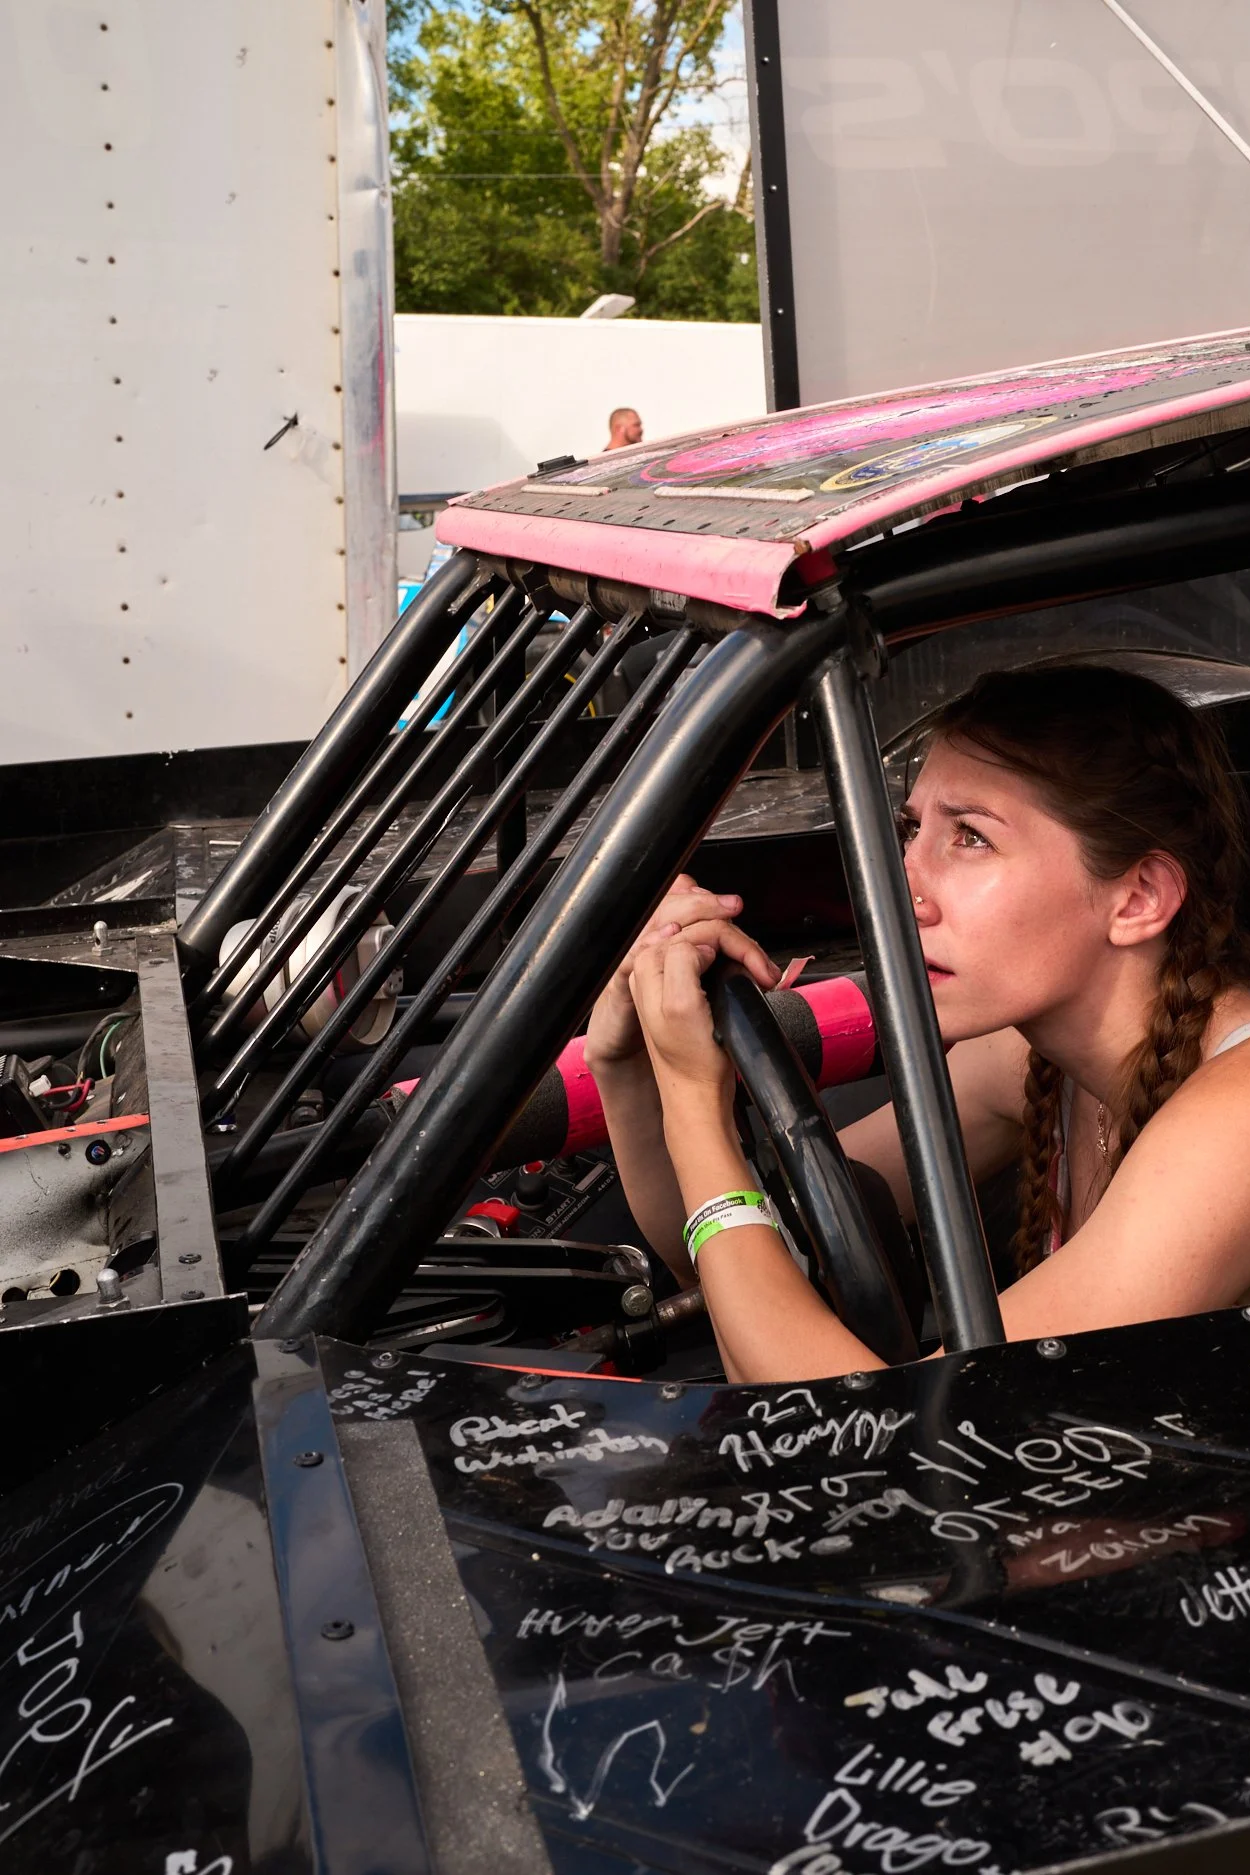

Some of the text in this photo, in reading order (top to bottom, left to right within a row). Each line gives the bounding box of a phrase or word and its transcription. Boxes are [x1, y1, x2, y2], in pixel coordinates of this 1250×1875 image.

[545, 1197, 572, 1225] START
[712, 1197, 744, 1213] Facebook
[833, 1743, 977, 1808] Lillie
